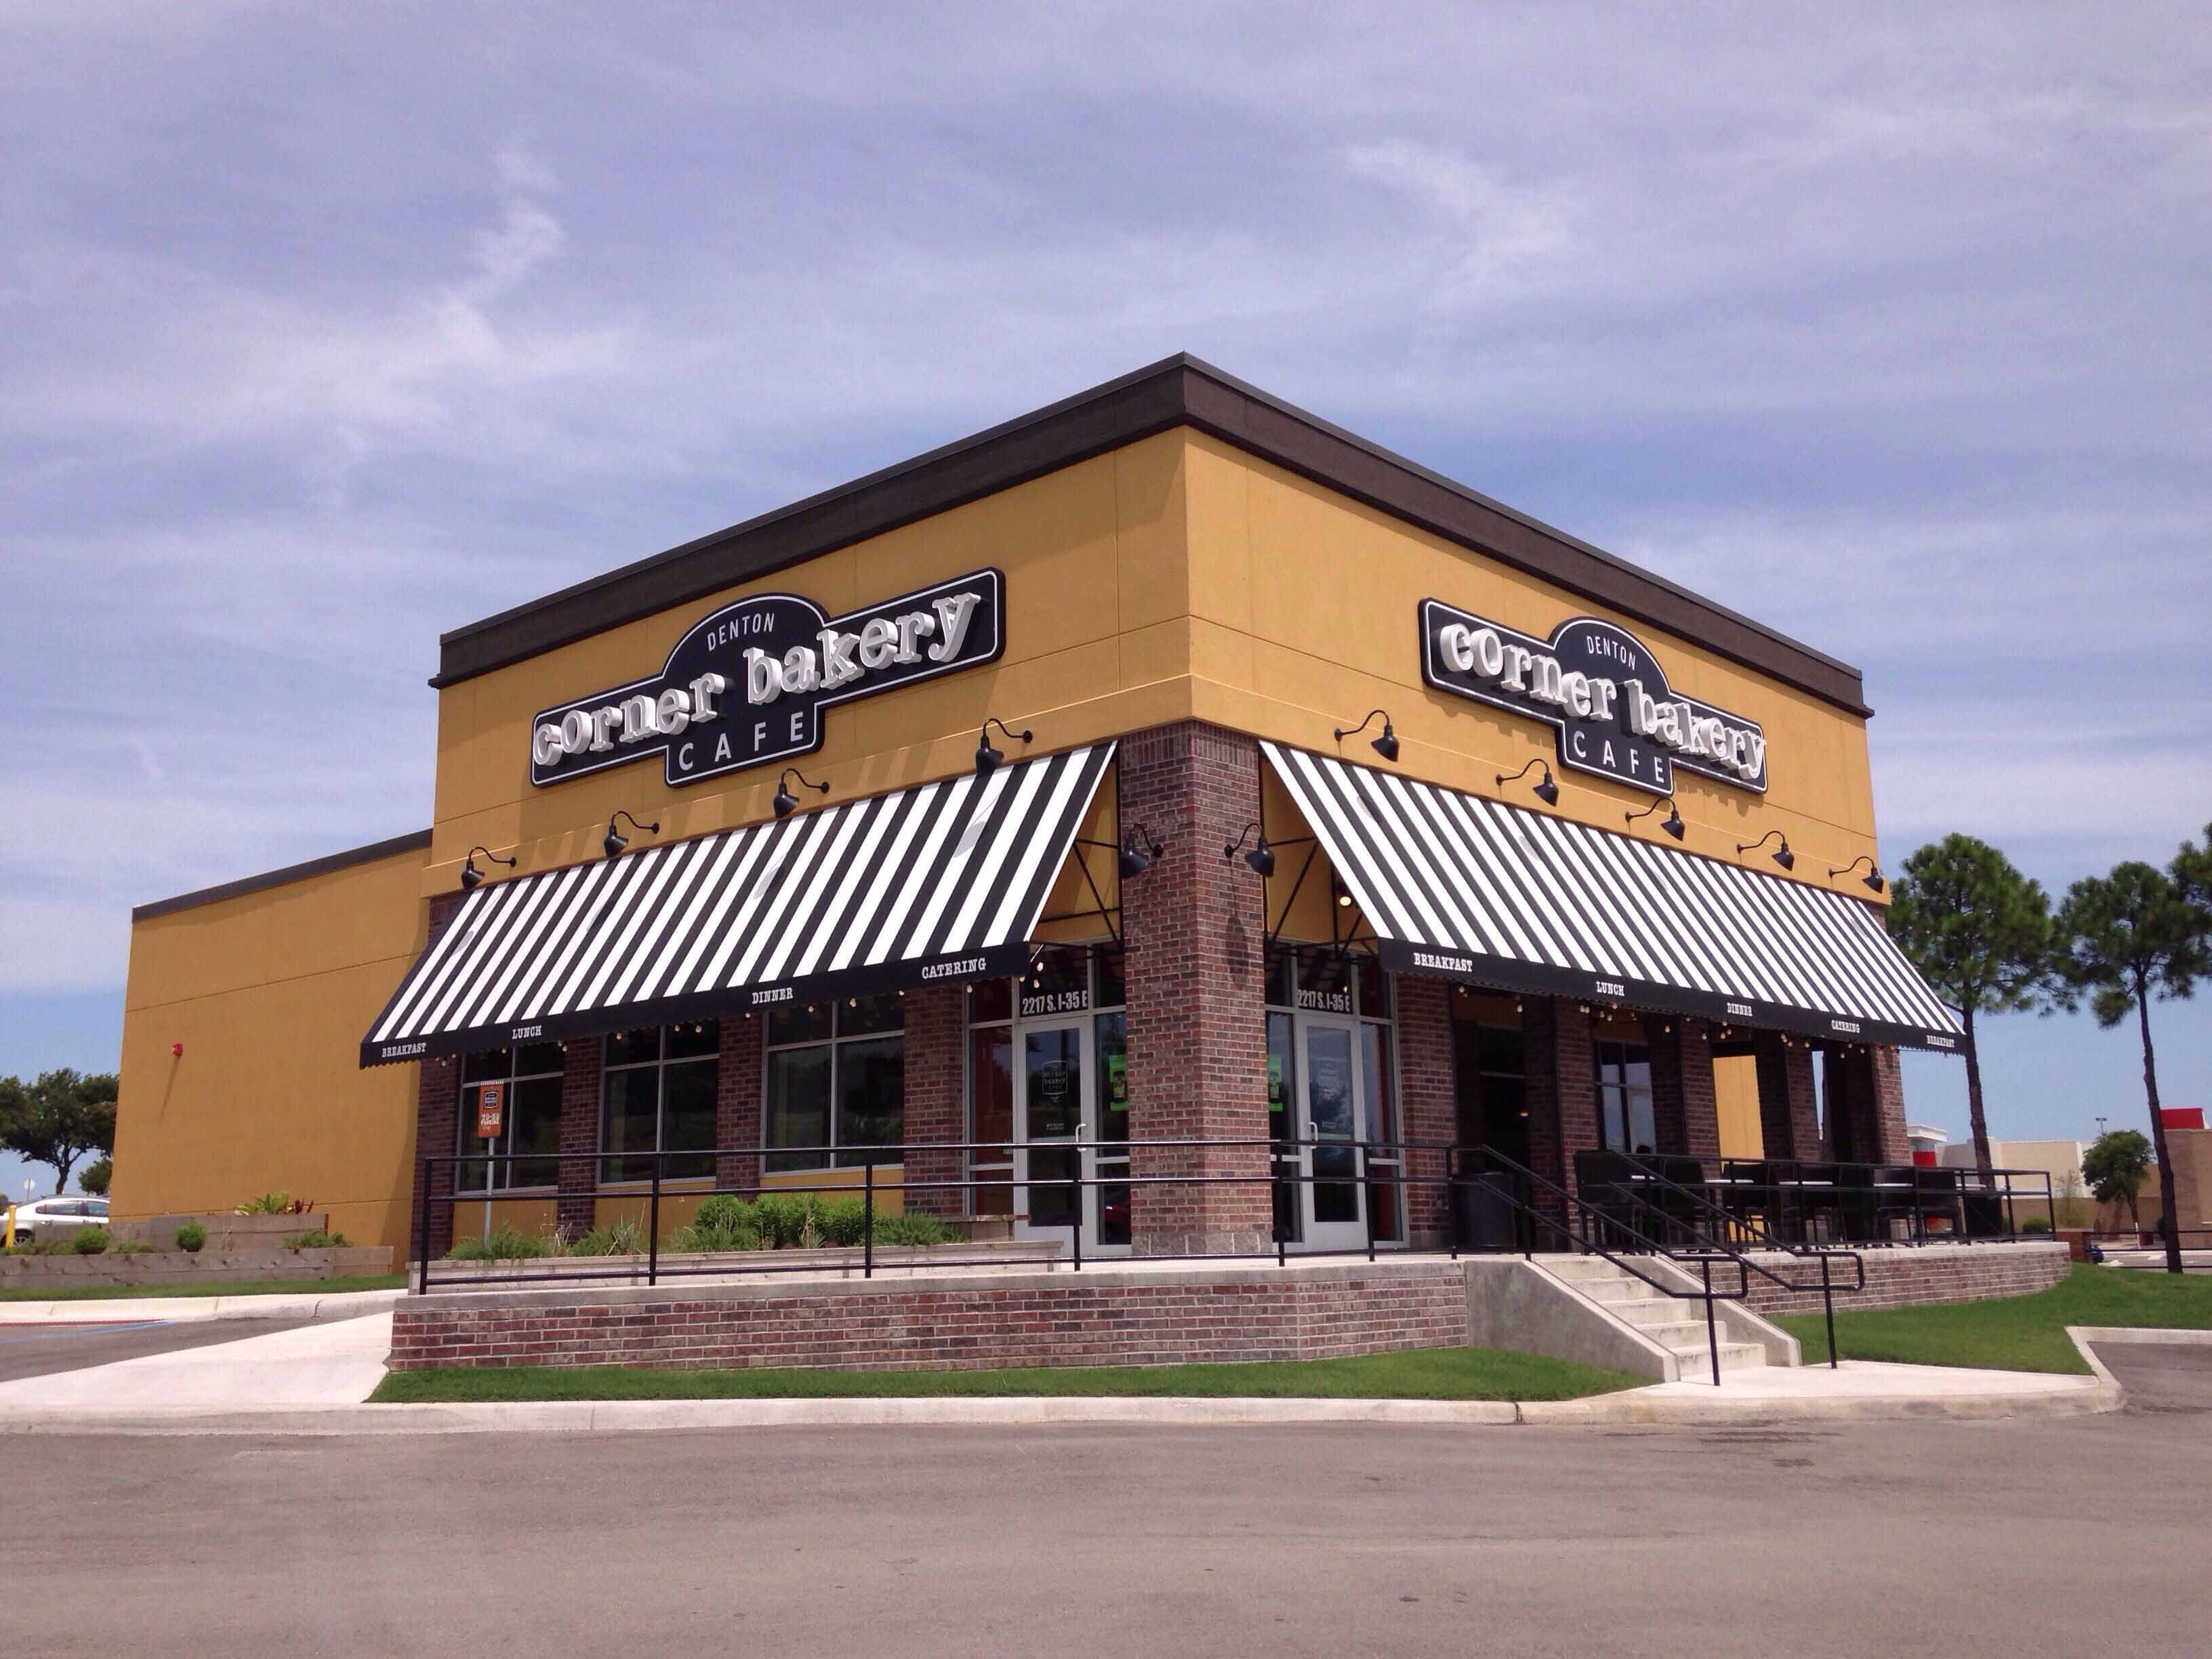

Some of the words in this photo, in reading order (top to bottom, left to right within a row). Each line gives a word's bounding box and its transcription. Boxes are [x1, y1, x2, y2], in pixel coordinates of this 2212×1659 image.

[706, 613, 775, 653] DENTON
[1586, 634, 1636, 671] DENTON
[533, 672, 726, 767] corner
[743, 592, 981, 705] bakery
[1439, 623, 1617, 721] corner
[1624, 678, 1767, 780] bakery
[678, 711, 804, 771] CAFE
[1573, 730, 1664, 783] CAFE
[921, 958, 987, 980] CATERING
[1413, 952, 1473, 972] BREAKFAST
[751, 987, 794, 1005] DINNER
[1297, 989, 1316, 1008] 2217
[1317, 991, 1326, 1009] S.
[1596, 981, 1626, 997] LUNCH
[1023, 996, 1045, 1015] 2217
[1046, 994, 1057, 1012] S.
[1058, 991, 1080, 1010] I-35
[1082, 990, 1088, 1008] E
[1726, 1002, 1753, 1017] DINNER
[512, 1025, 543, 1040] LUNCH
[1831, 1019, 1860, 1034] CATERING
[381, 1042, 427, 1058] BREAKFAST
